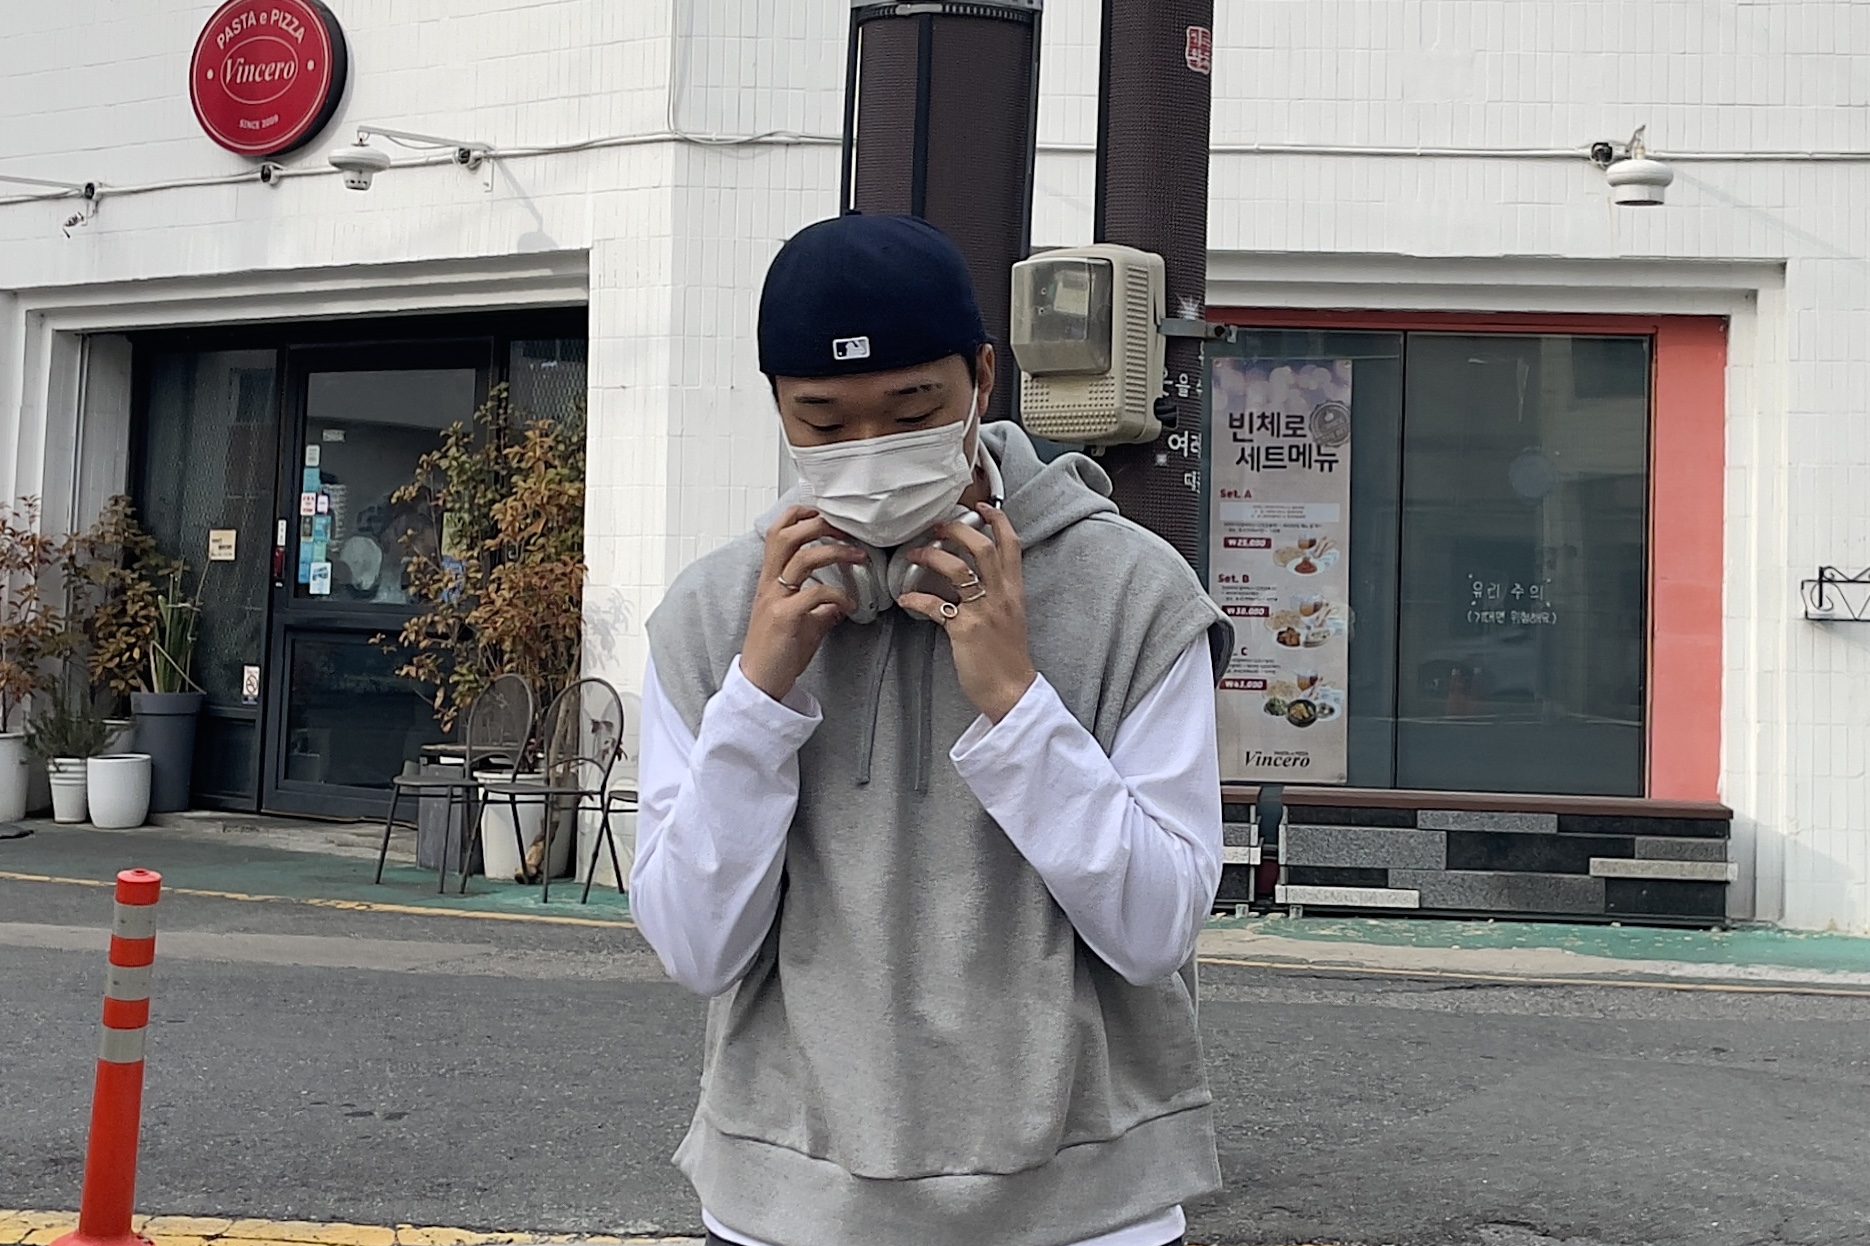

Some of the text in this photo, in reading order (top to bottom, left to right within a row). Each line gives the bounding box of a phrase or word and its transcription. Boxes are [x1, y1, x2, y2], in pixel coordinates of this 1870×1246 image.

[216, 8, 306, 50] PASTA e PIZZA
[226, 57, 295, 84] Vincero
[239, 118, 261, 130] SINCE
[1228, 411, 1307, 443] 빈체로
[1235, 443, 1339, 473] 세트메뉴
[1220, 488, 1252, 499] Set. A
[1218, 574, 1250, 583] Set. B
[1472, 581, 1544, 601] 유리 주의
[1244, 751, 1311, 768] Vincero
